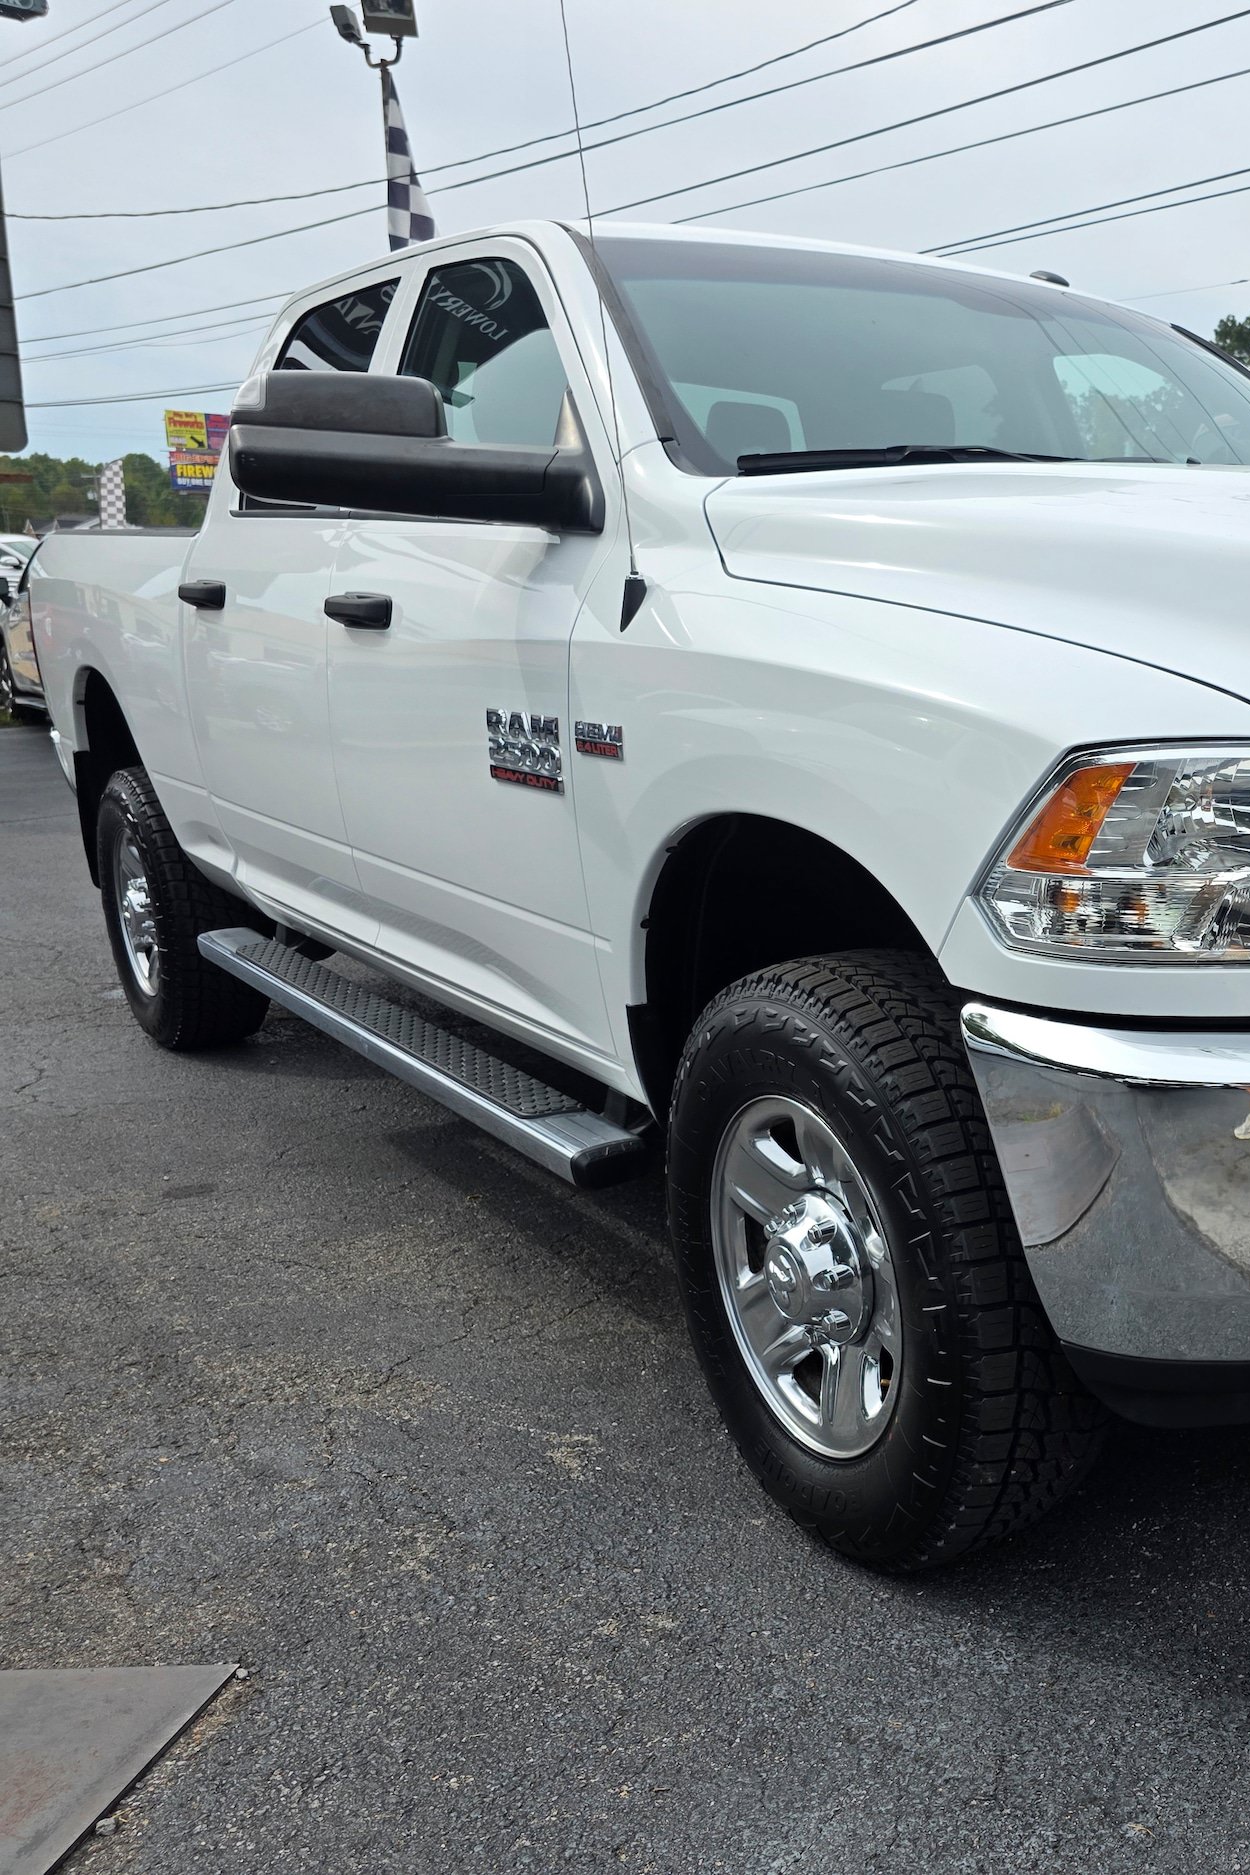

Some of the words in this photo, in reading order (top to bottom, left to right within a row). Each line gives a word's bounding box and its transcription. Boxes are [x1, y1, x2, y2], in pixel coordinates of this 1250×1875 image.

[486, 707, 559, 743] RAM
[575, 720, 623, 743] HEMI
[489, 735, 562, 776] 2500
[592, 742, 618, 758] LITER
[492, 767, 525, 782] HEAVY
[526, 772, 557, 790] DUTY
